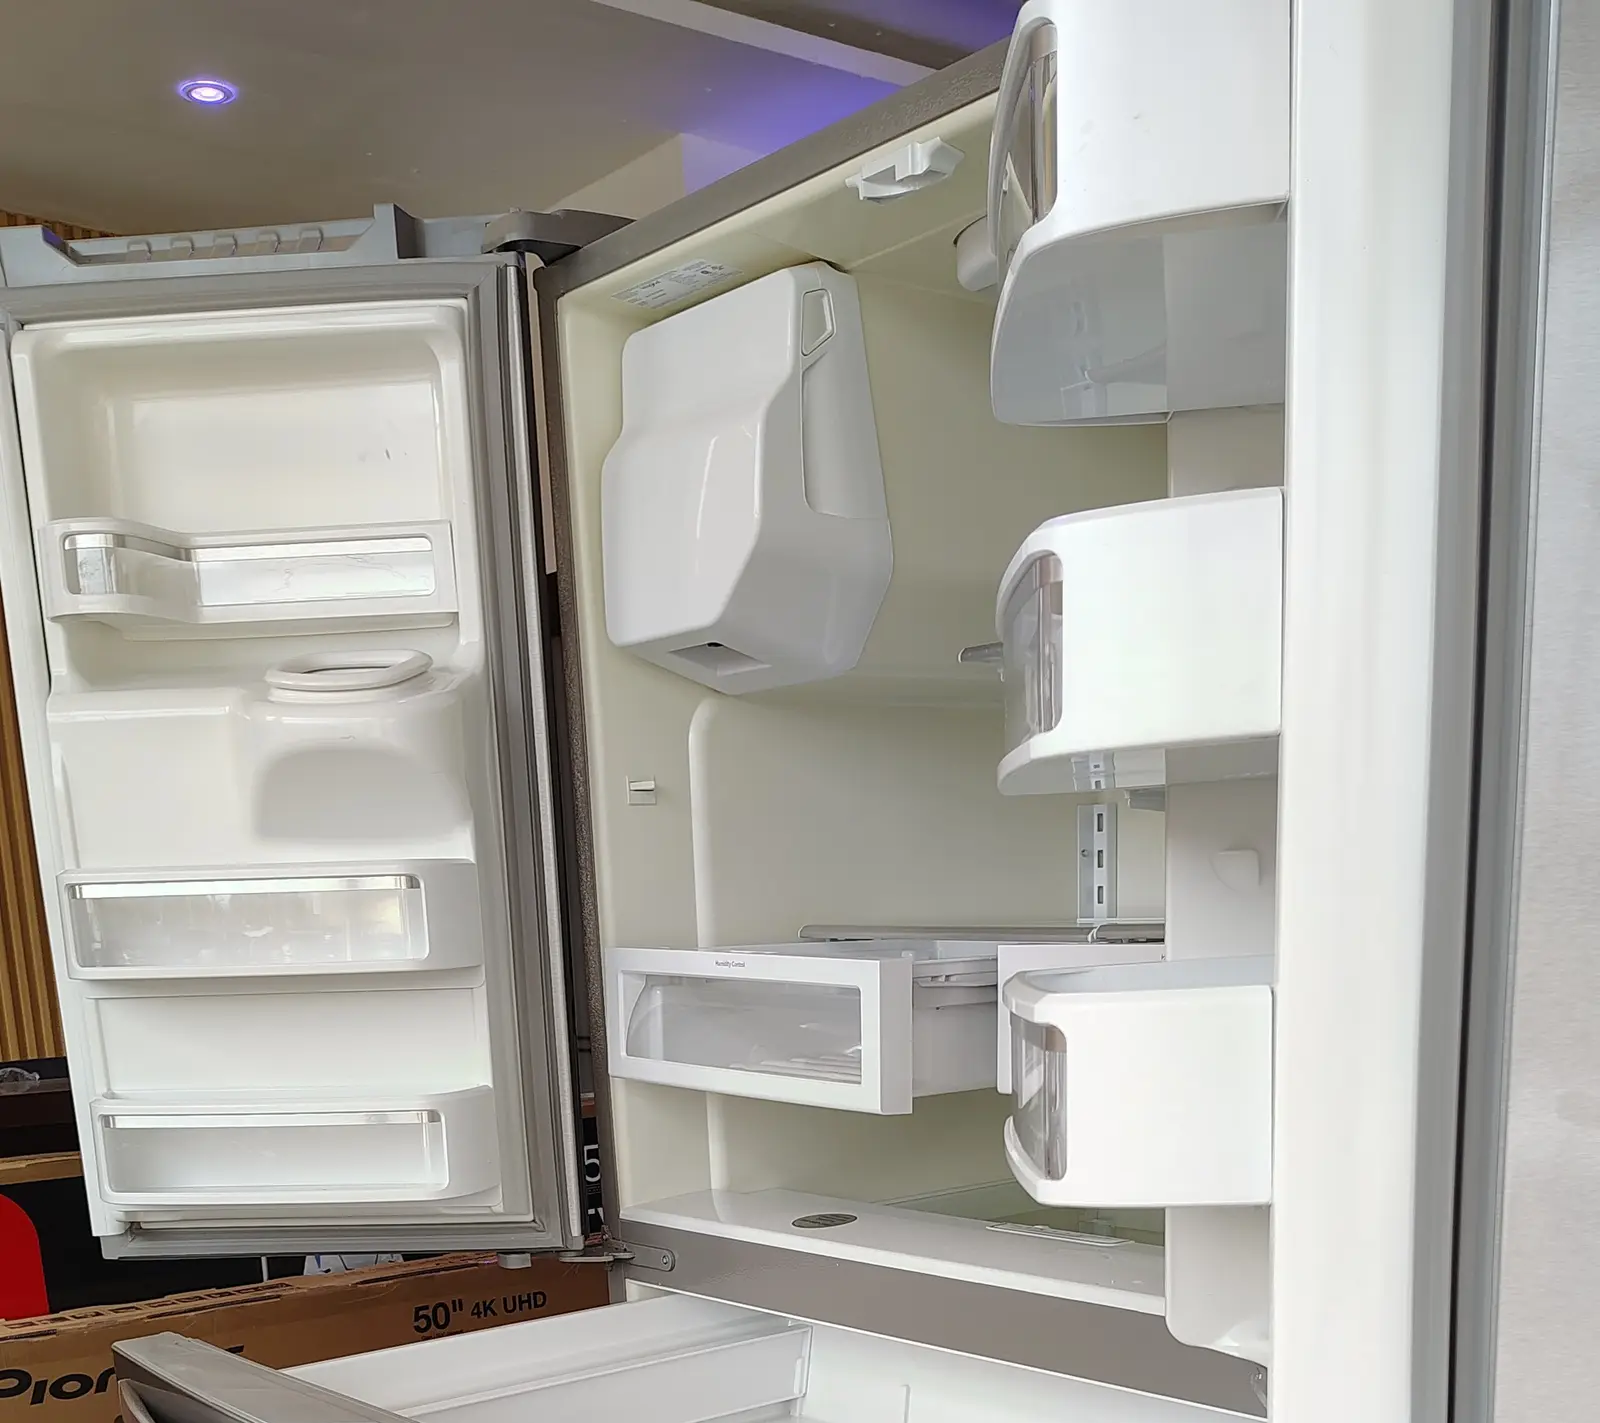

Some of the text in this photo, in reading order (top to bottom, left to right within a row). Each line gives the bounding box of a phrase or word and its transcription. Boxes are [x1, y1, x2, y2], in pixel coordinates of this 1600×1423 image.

[413, 1291, 547, 1334] 50" 4K UHD
